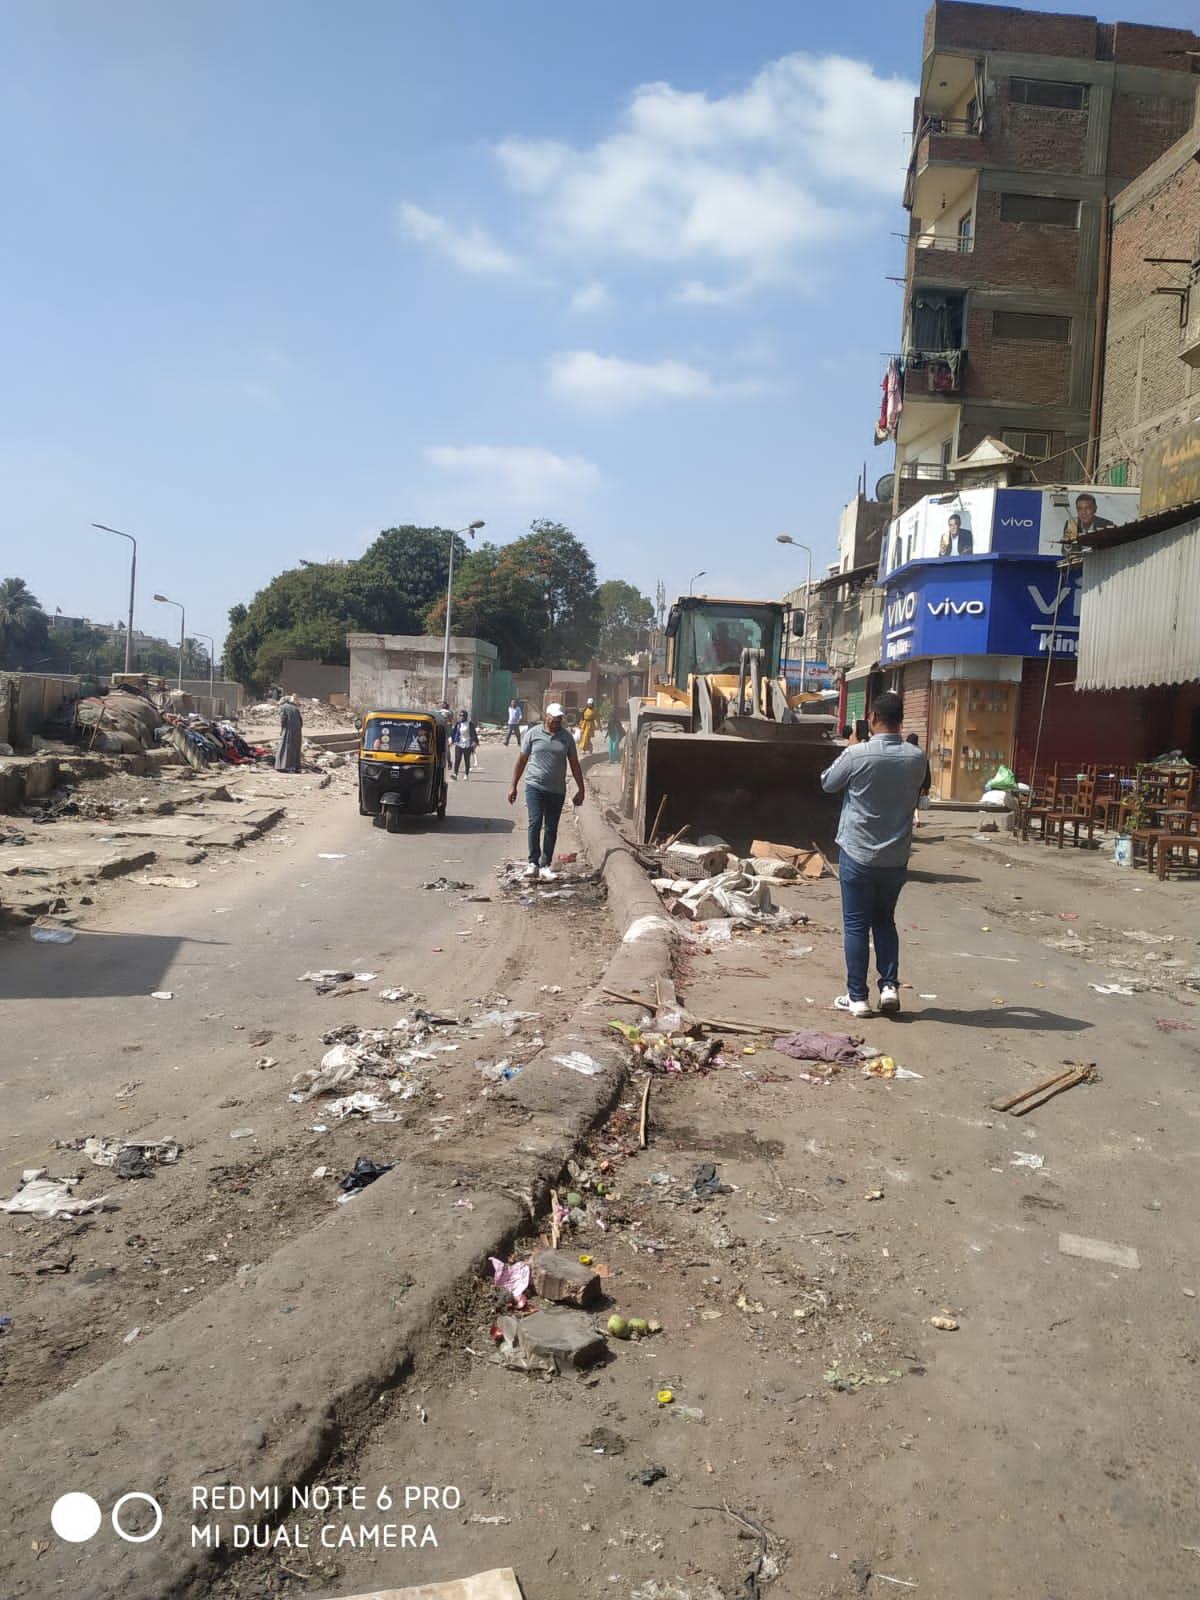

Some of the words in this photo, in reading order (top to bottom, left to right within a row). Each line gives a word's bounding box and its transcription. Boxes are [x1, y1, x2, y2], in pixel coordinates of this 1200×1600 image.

[1000, 516, 1034, 528] vivo
[887, 591, 915, 627] vivo
[927, 597, 984, 616] vivo
[1027, 576, 1081, 617] vi
